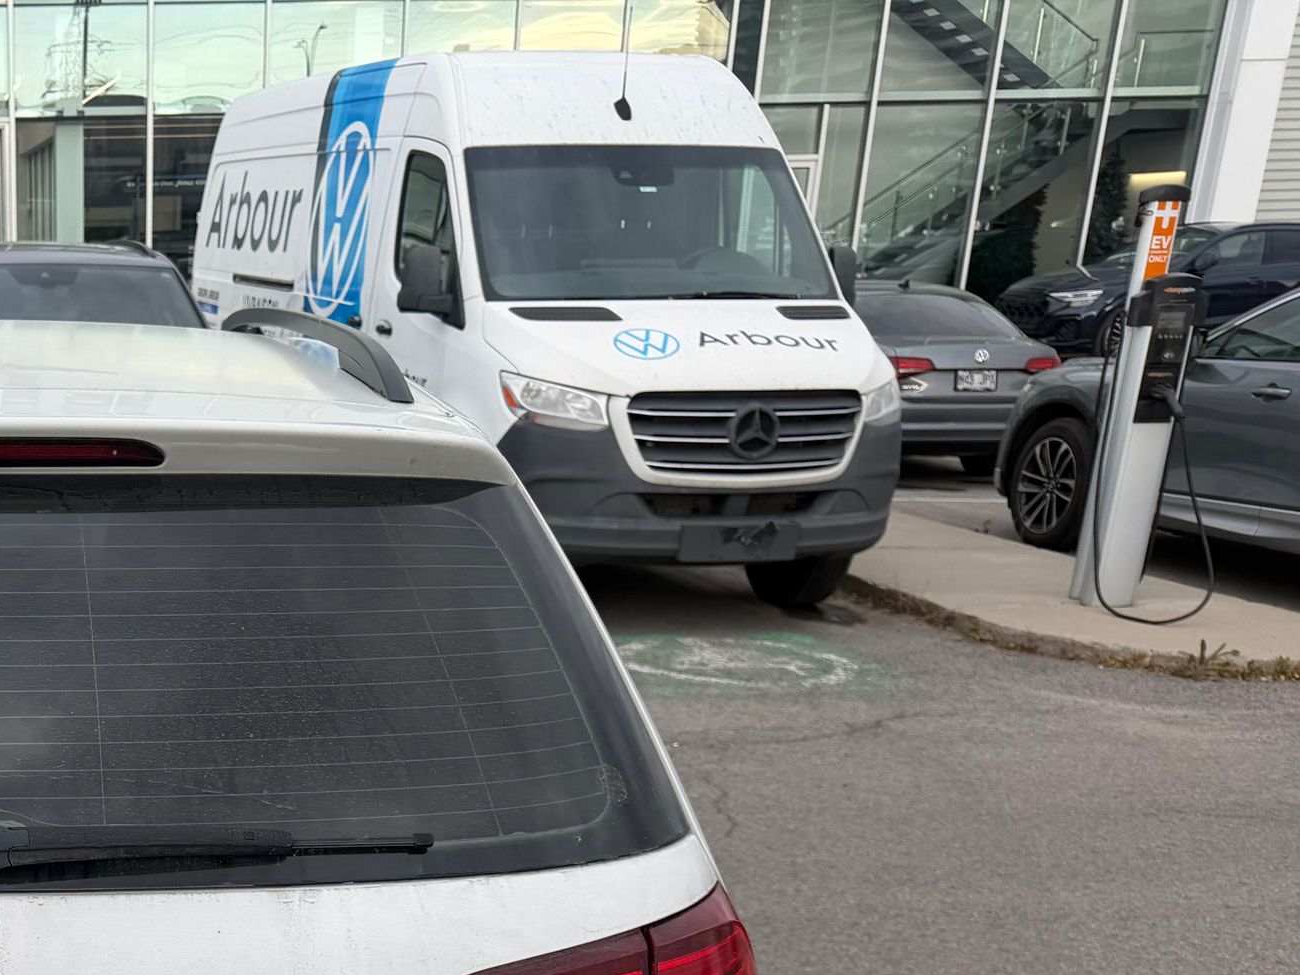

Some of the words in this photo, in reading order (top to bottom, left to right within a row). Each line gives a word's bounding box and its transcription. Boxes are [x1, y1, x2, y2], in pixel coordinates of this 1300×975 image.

[206, 169, 304, 253] Arbour
[1152, 235, 1172, 250] EV
[1149, 254, 1169, 263] ONLY
[698, 330, 839, 352] Arbour
